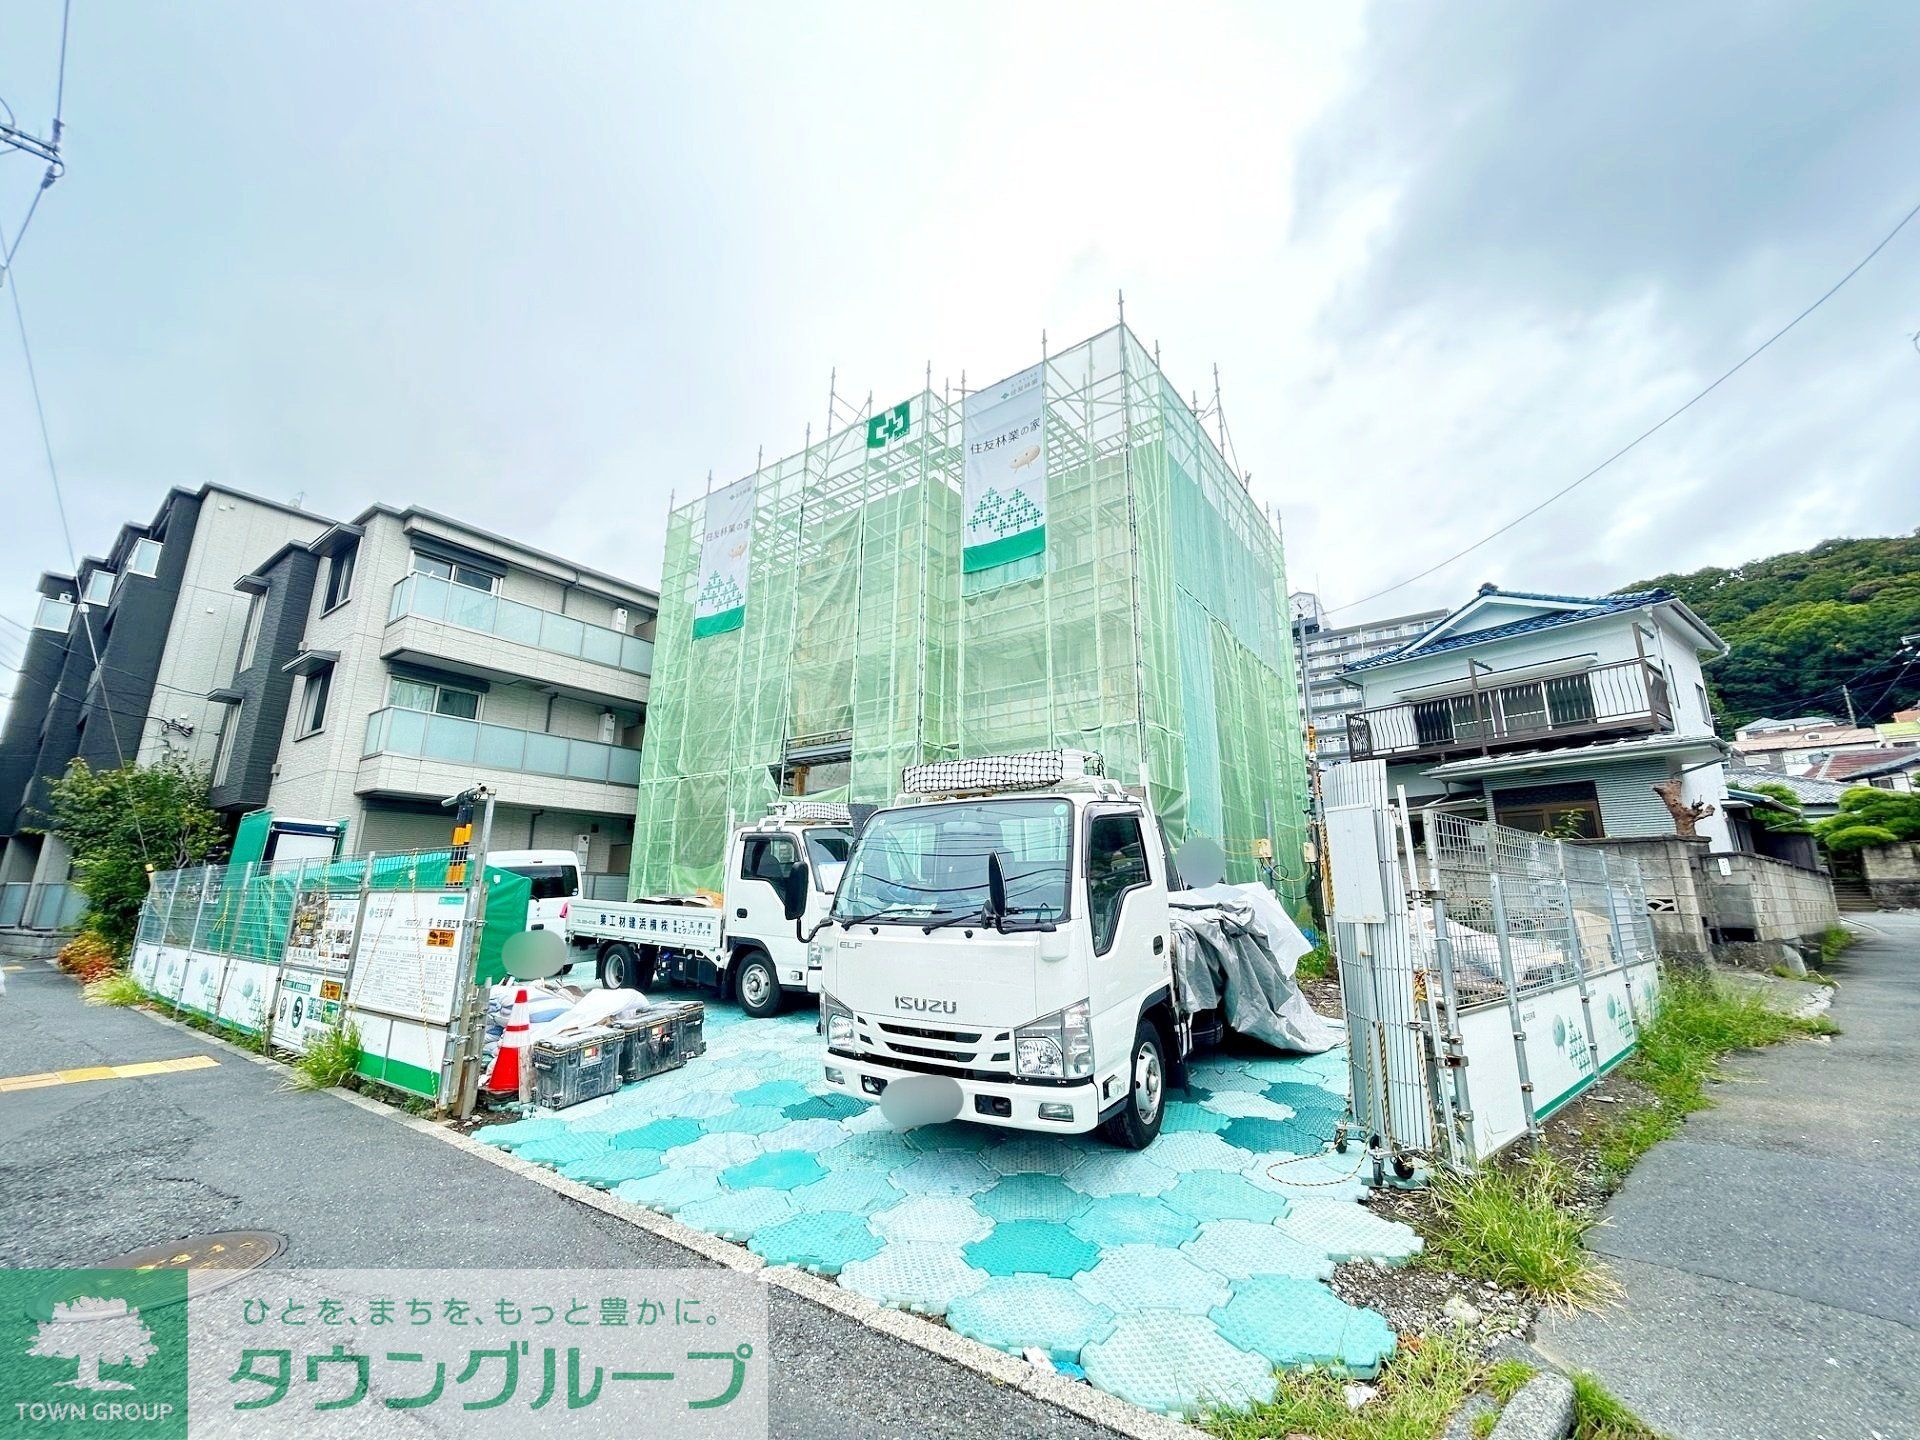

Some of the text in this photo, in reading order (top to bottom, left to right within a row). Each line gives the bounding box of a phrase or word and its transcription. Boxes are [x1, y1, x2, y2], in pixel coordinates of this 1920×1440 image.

[970, 417, 1040, 455] 住友林業の家
[839, 941, 862, 950] ELF
[894, 994, 957, 1015] ISUZU
